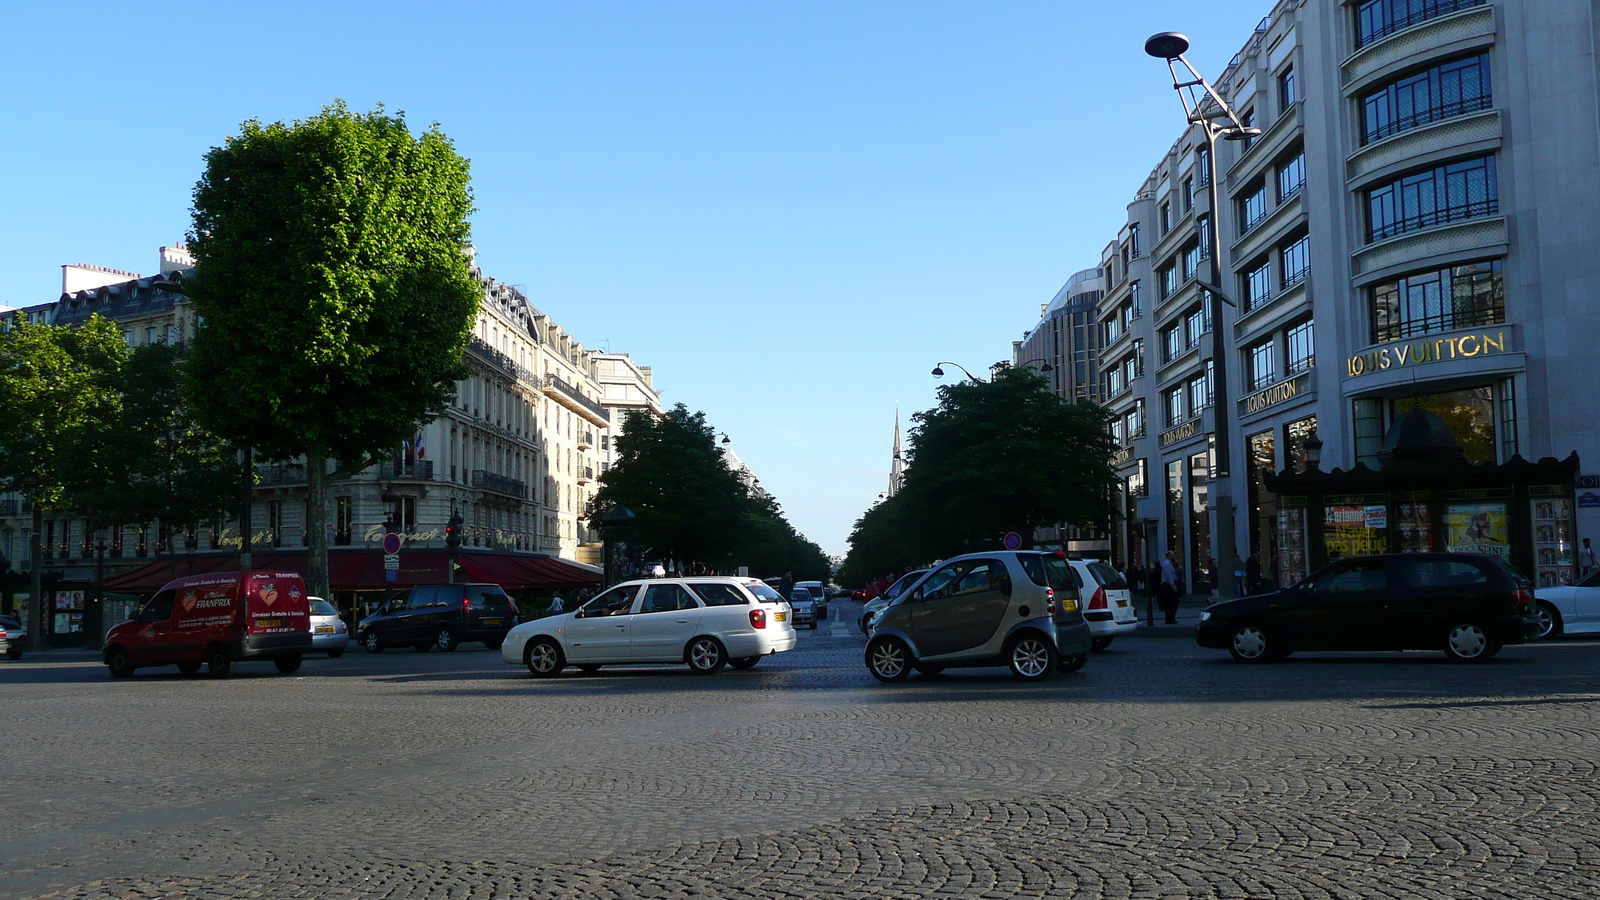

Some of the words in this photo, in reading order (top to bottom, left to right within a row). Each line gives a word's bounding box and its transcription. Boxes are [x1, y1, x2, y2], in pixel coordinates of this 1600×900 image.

[1347, 349, 1392, 377] LOUIS
[1394, 332, 1505, 366] VUITTON
[1247, 392, 1266, 413] LOUIS
[1265, 379, 1297, 406] VUITTON
[217, 529, 273, 550] Fouqet's
[364, 524, 449, 547] Foquet's
[1326, 540, 1350, 556] pas
[1351, 536, 1388, 555] peur!
[196, 597, 232, 609] FRANPRIX
